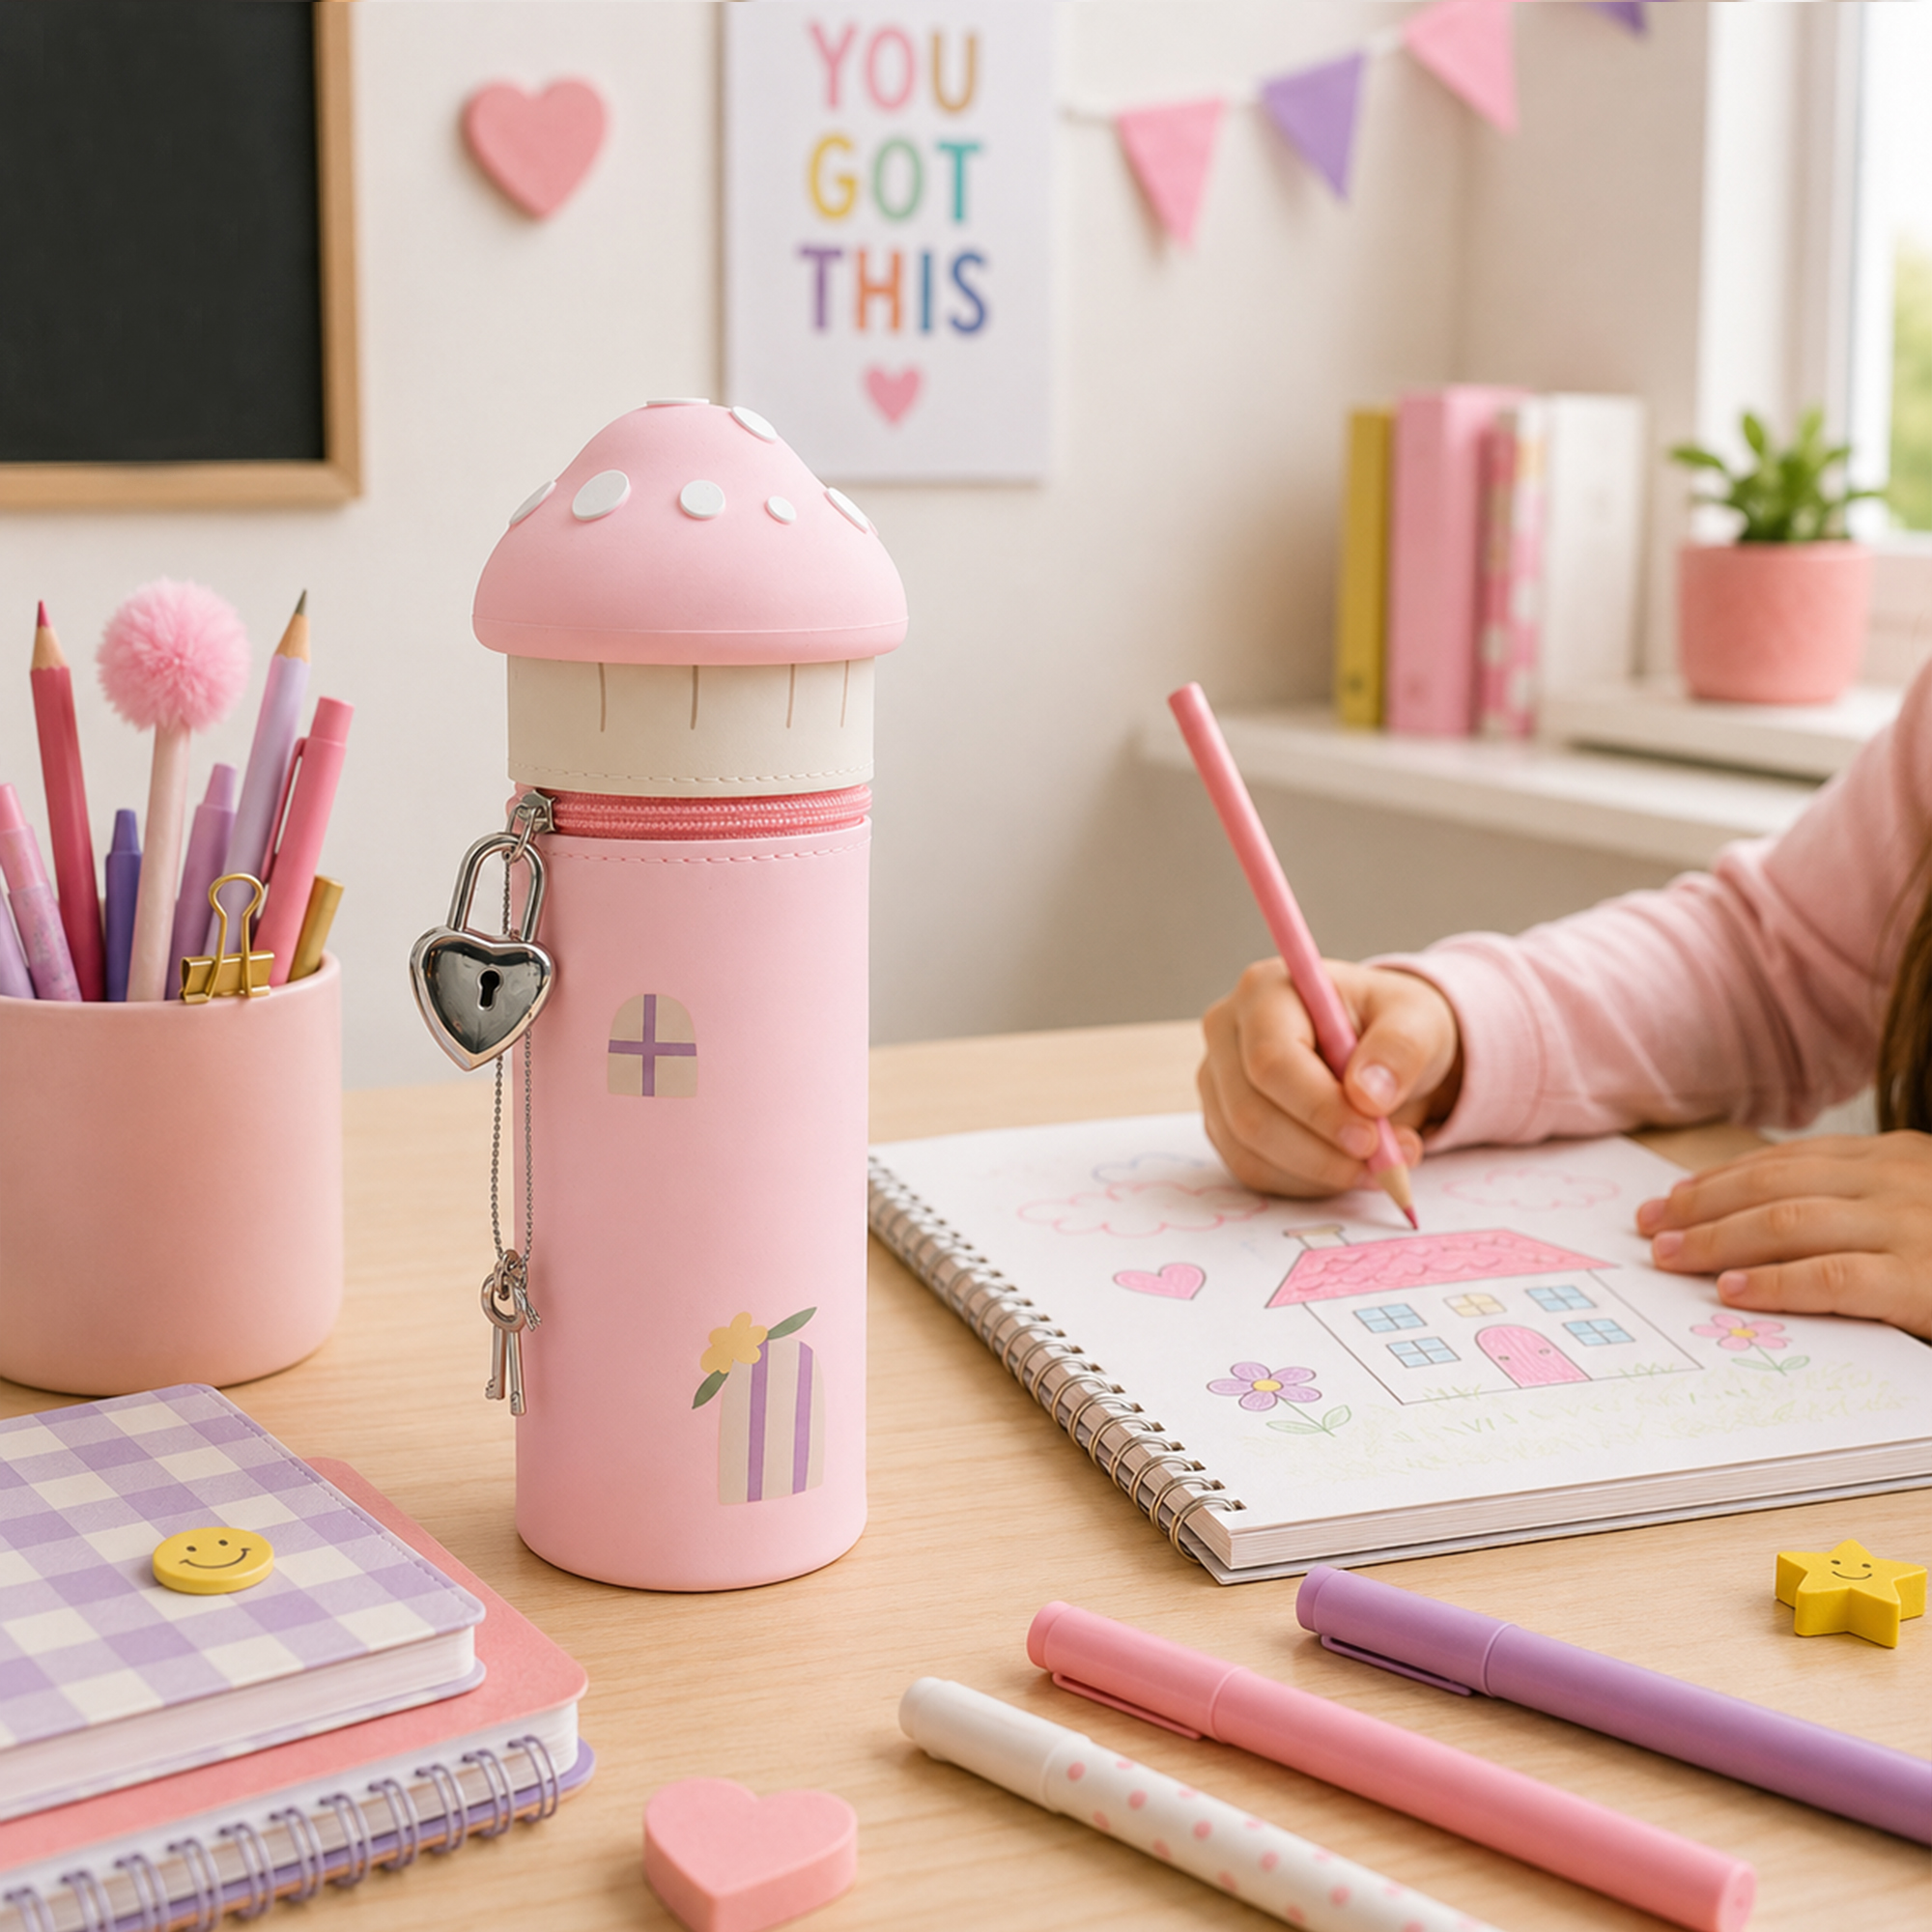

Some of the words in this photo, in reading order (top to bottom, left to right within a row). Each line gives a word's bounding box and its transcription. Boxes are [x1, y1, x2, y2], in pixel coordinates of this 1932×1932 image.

[809, 18, 980, 113] YOU
[808, 132, 983, 224] GOT
[798, 245, 989, 335] THIS
